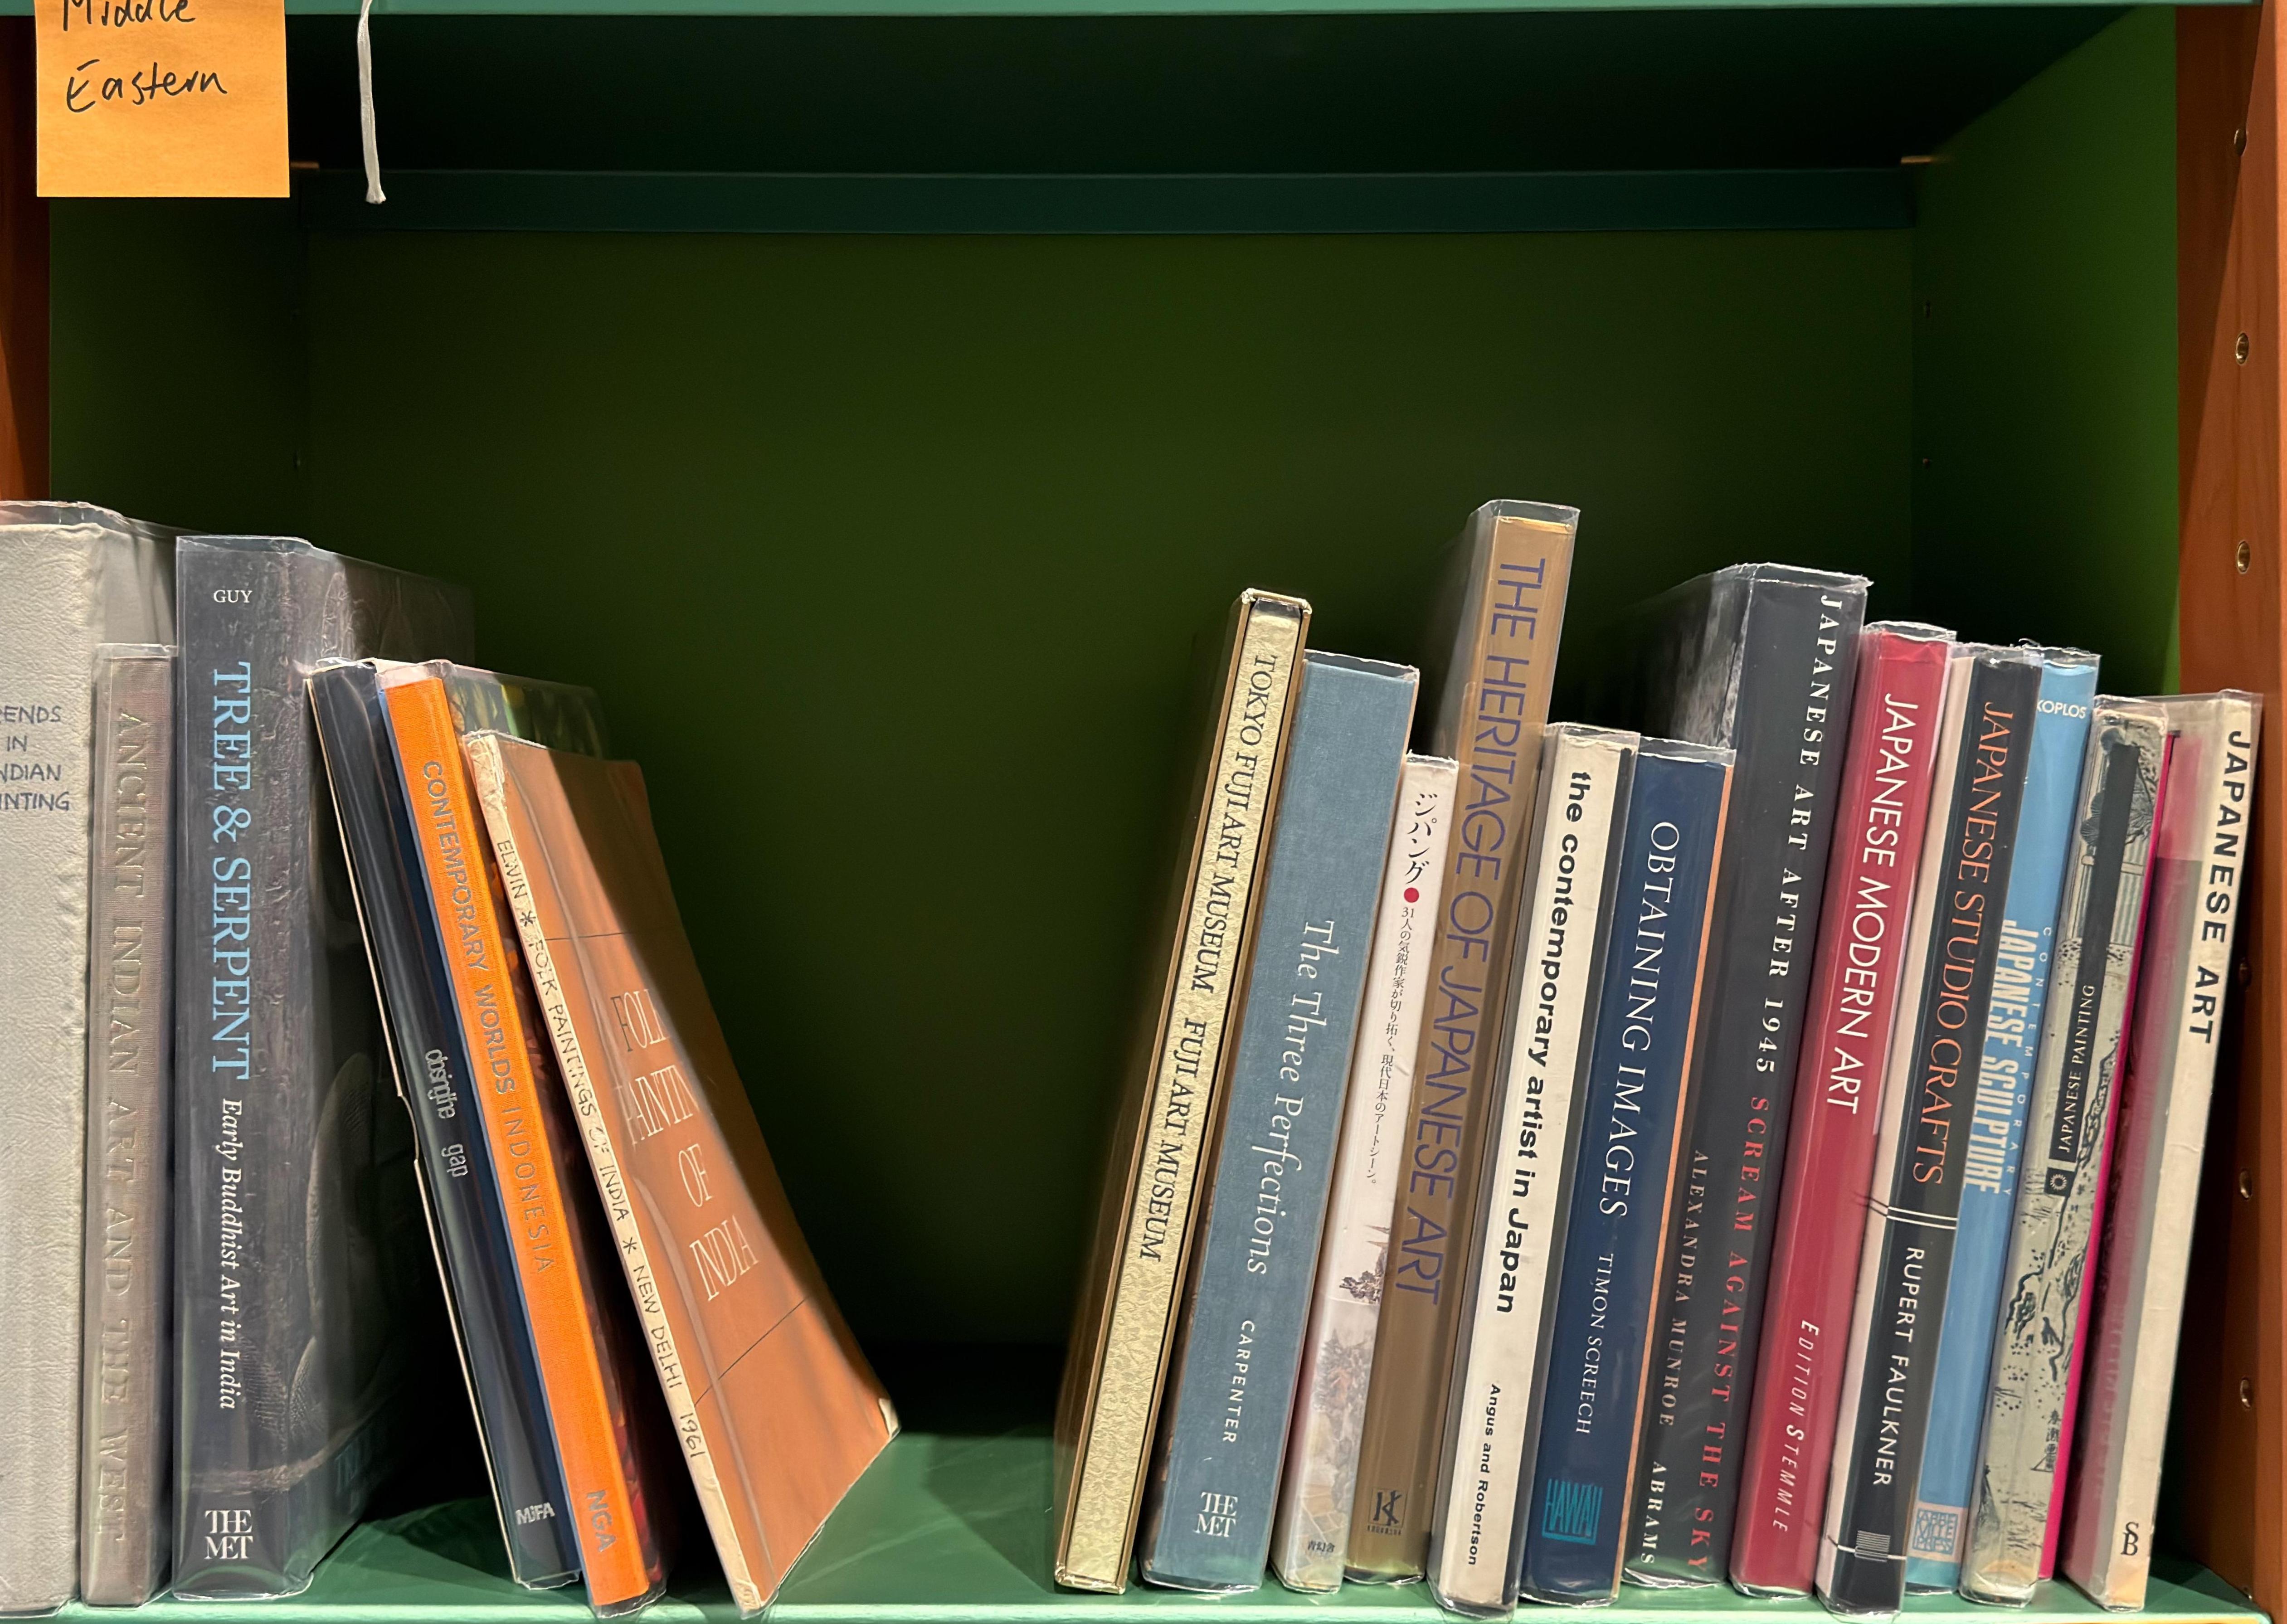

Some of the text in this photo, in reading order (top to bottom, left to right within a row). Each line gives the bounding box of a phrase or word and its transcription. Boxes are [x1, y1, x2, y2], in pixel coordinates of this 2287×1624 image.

[63, 0, 196, 31] Middle
[66, 59, 228, 113] Eastern
[213, 589, 253, 603] GUY
[0, 705, 61, 724] ENDS
[7, 735, 27, 752] IN
[212, 661, 251, 1080] TREE & SERPENT
[1192, 655, 1278, 993] TOKYO FUJI ART MUSEUM
[1405, 792, 1438, 885] ジパング
[1756, 595, 1842, 1073] JAPANESE ART AFTER 1945
[1827, 693, 1918, 1114] JAPANESE MODERN ART
[2189, 731, 2251, 1044] JAPANESE ART
[423, 761, 555, 1272] CONTEMPORARY WORLDS INDONESIA
[1396, 558, 1546, 1306] THE HERITAGE OF JAPANESE ART
[1599, 821, 1680, 1217] OBTAINING IMAGES
[1912, 701, 2014, 1185] JAPANESE STUDIO CRAFTS
[96, 710, 150, 1542] ANCIENT INDIAN ART AND THE WEST
[1139, 1017, 1207, 1262] FUJI ART MUSEUM
[1247, 920, 1339, 1275] The Three Perfections
[1496, 772, 1591, 1313] the contemporary artist in Japan
[1964, 919, 2039, 1194] JAPANESE SCULPTURE
[2003, 927, 2051, 1195] CONTEMPORARY
[2058, 984, 2095, 1153] JAPANESE PAINTING
[215, 1099, 243, 1409] Early Buddhist Art in India
[441, 1143, 468, 1178] gap
[497, 840, 528, 898] ELWIN
[529, 939, 557, 996] FOLK
[549, 1004, 597, 1117] PAINTINGS
[600, 1166, 630, 1221] INDIA
[633, 1265, 661, 1314] NEW
[651, 1326, 682, 1389] DELHI
[680, 1412, 706, 1458] 1961
[678, 1143, 714, 1207] OF
[690, 1215, 759, 1302] INDIA
[1576, 1254, 1614, 1434] TIMON SCREECH
[1659, 1149, 1709, 1427] ALEXANDRA MUNROE
[1687, 1096, 1769, 1571] SCREAM AGAINST THE SKY
[1222, 1320, 1255, 1443] CARPENTER
[1772, 1320, 1820, 1532] EDITION STEMMLE
[1873, 1247, 1925, 1486] RUPERT FAULKNER
[205, 1510, 252, 1534] THE
[205, 1536, 253, 1559] MET
[515, 1502, 555, 1525] MiFA
[586, 1490, 617, 1553] NGA
[1195, 1514, 1236, 1538] MET
[1201, 1492, 1238, 1517] THE
[1468, 1384, 1501, 1566] Angus and Robertson
[1640, 1461, 1668, 1565] ABRAMS
